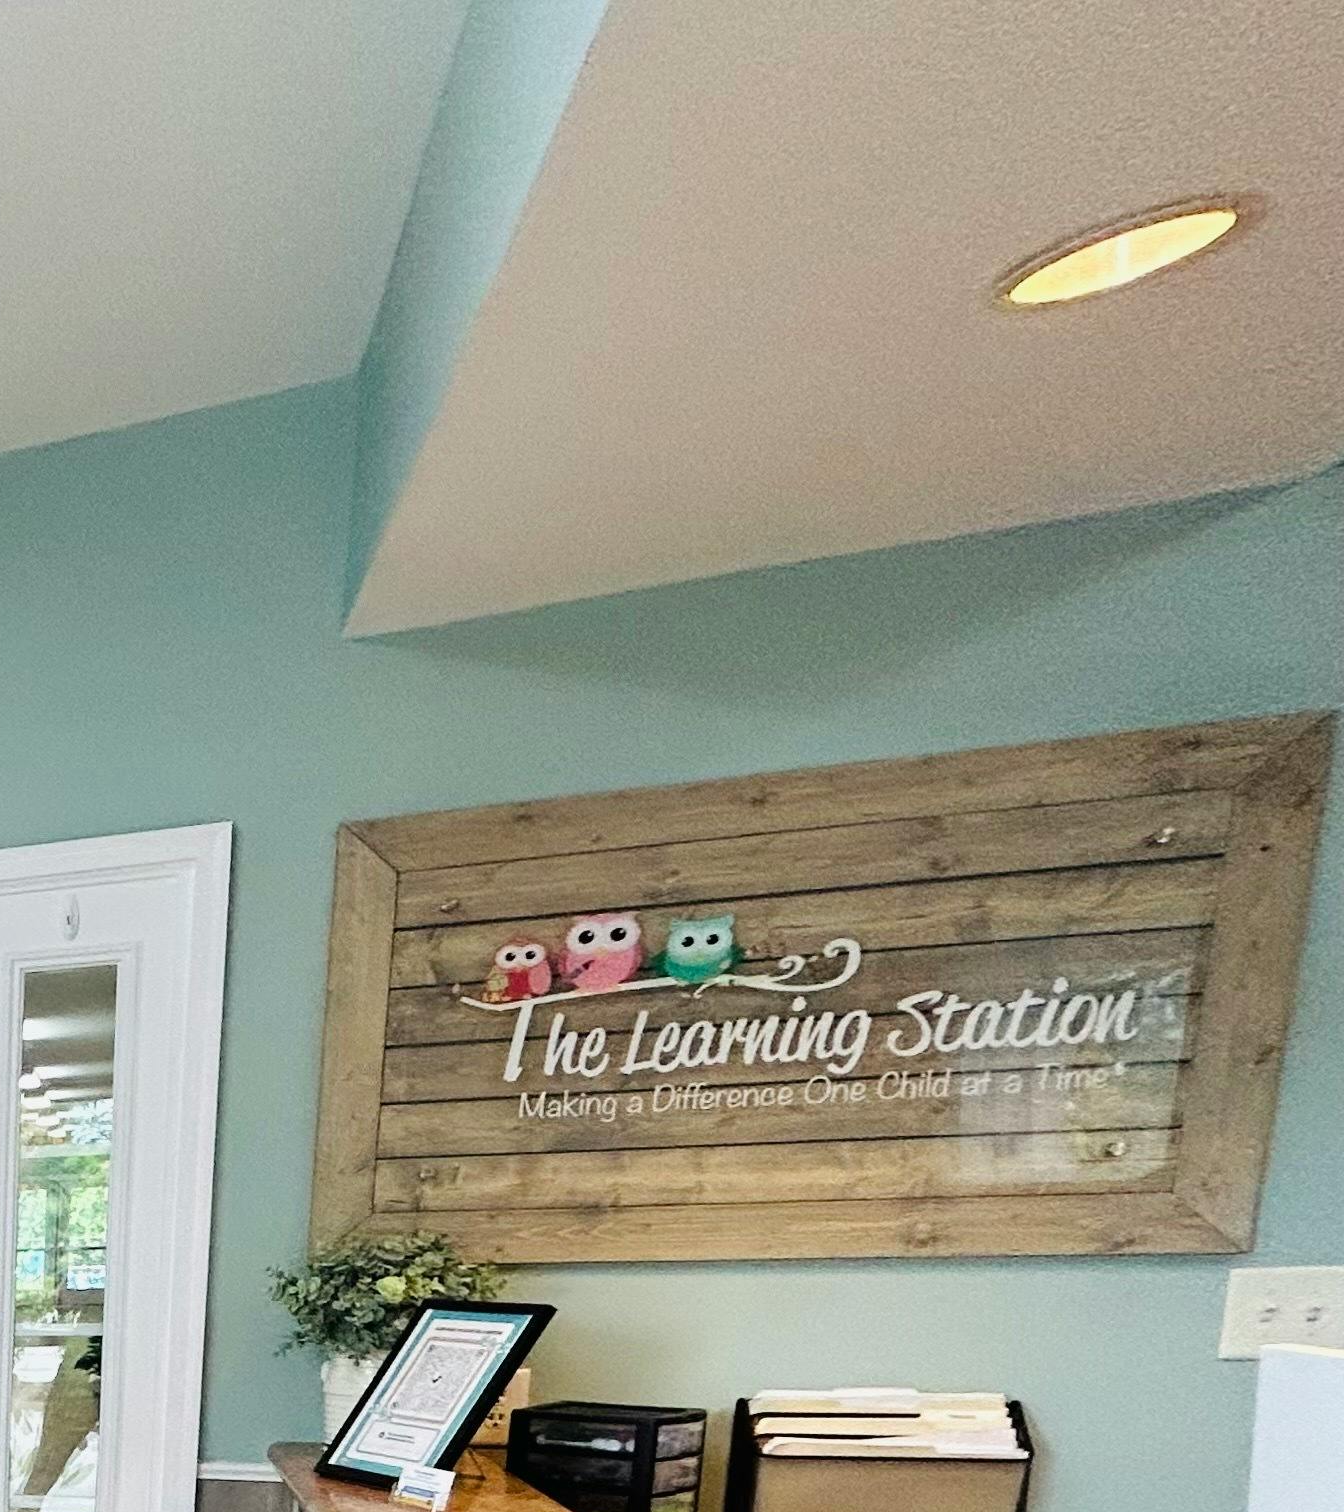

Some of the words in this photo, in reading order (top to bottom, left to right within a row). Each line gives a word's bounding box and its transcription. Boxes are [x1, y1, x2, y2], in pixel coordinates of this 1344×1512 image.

[503, 1002, 610, 1083] The
[620, 995, 872, 1075] Learning
[887, 976, 1139, 1057] Station
[518, 1091, 618, 1123] Making
[625, 1093, 643, 1115] a
[651, 1082, 795, 1114] Difference
[804, 1074, 867, 1105] One
[876, 1067, 952, 1101] Child
[960, 1071, 993, 1097] at
[1002, 1073, 1024, 1095] a
[1038, 1062, 1109, 1091] Time
